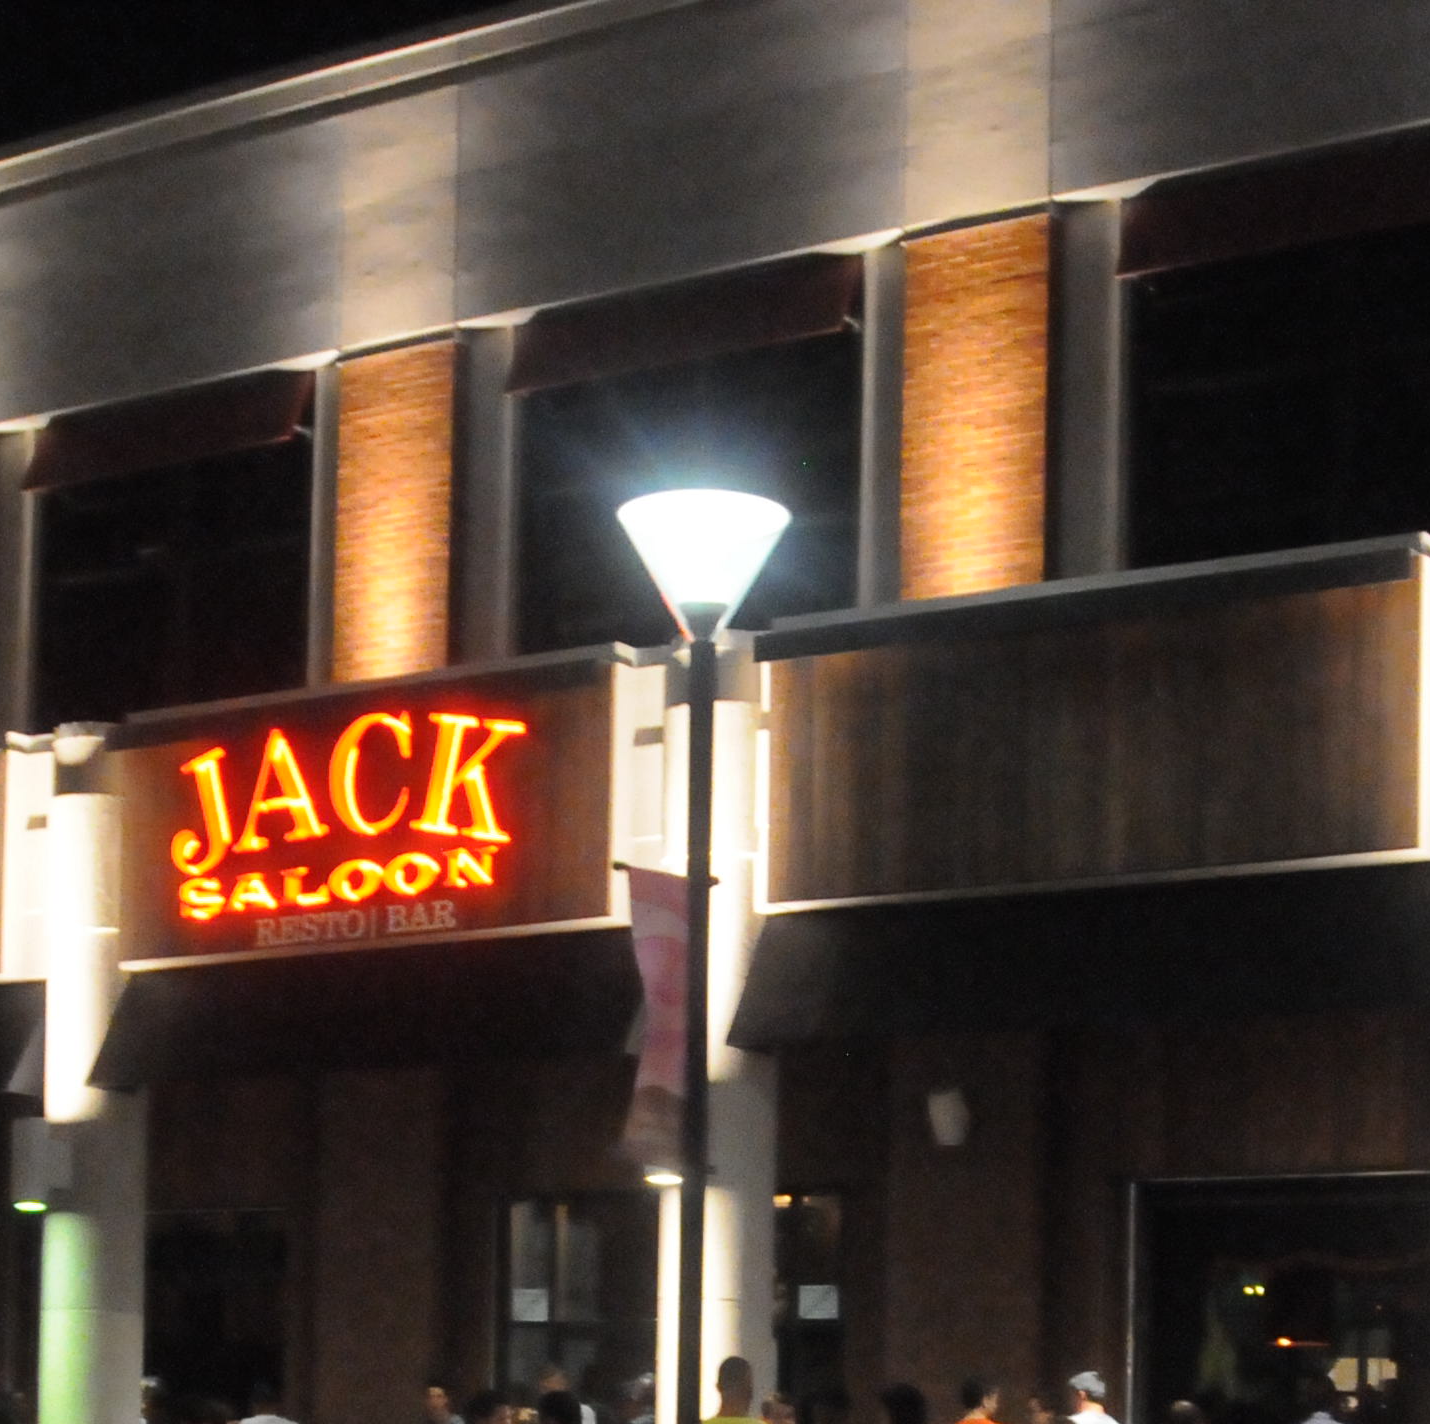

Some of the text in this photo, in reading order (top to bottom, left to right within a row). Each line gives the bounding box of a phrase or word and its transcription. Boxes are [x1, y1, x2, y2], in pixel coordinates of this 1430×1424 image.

[171, 709, 527, 876] JACK
[178, 845, 500, 920] SALOON
[254, 899, 457, 948] RESTO BAR
